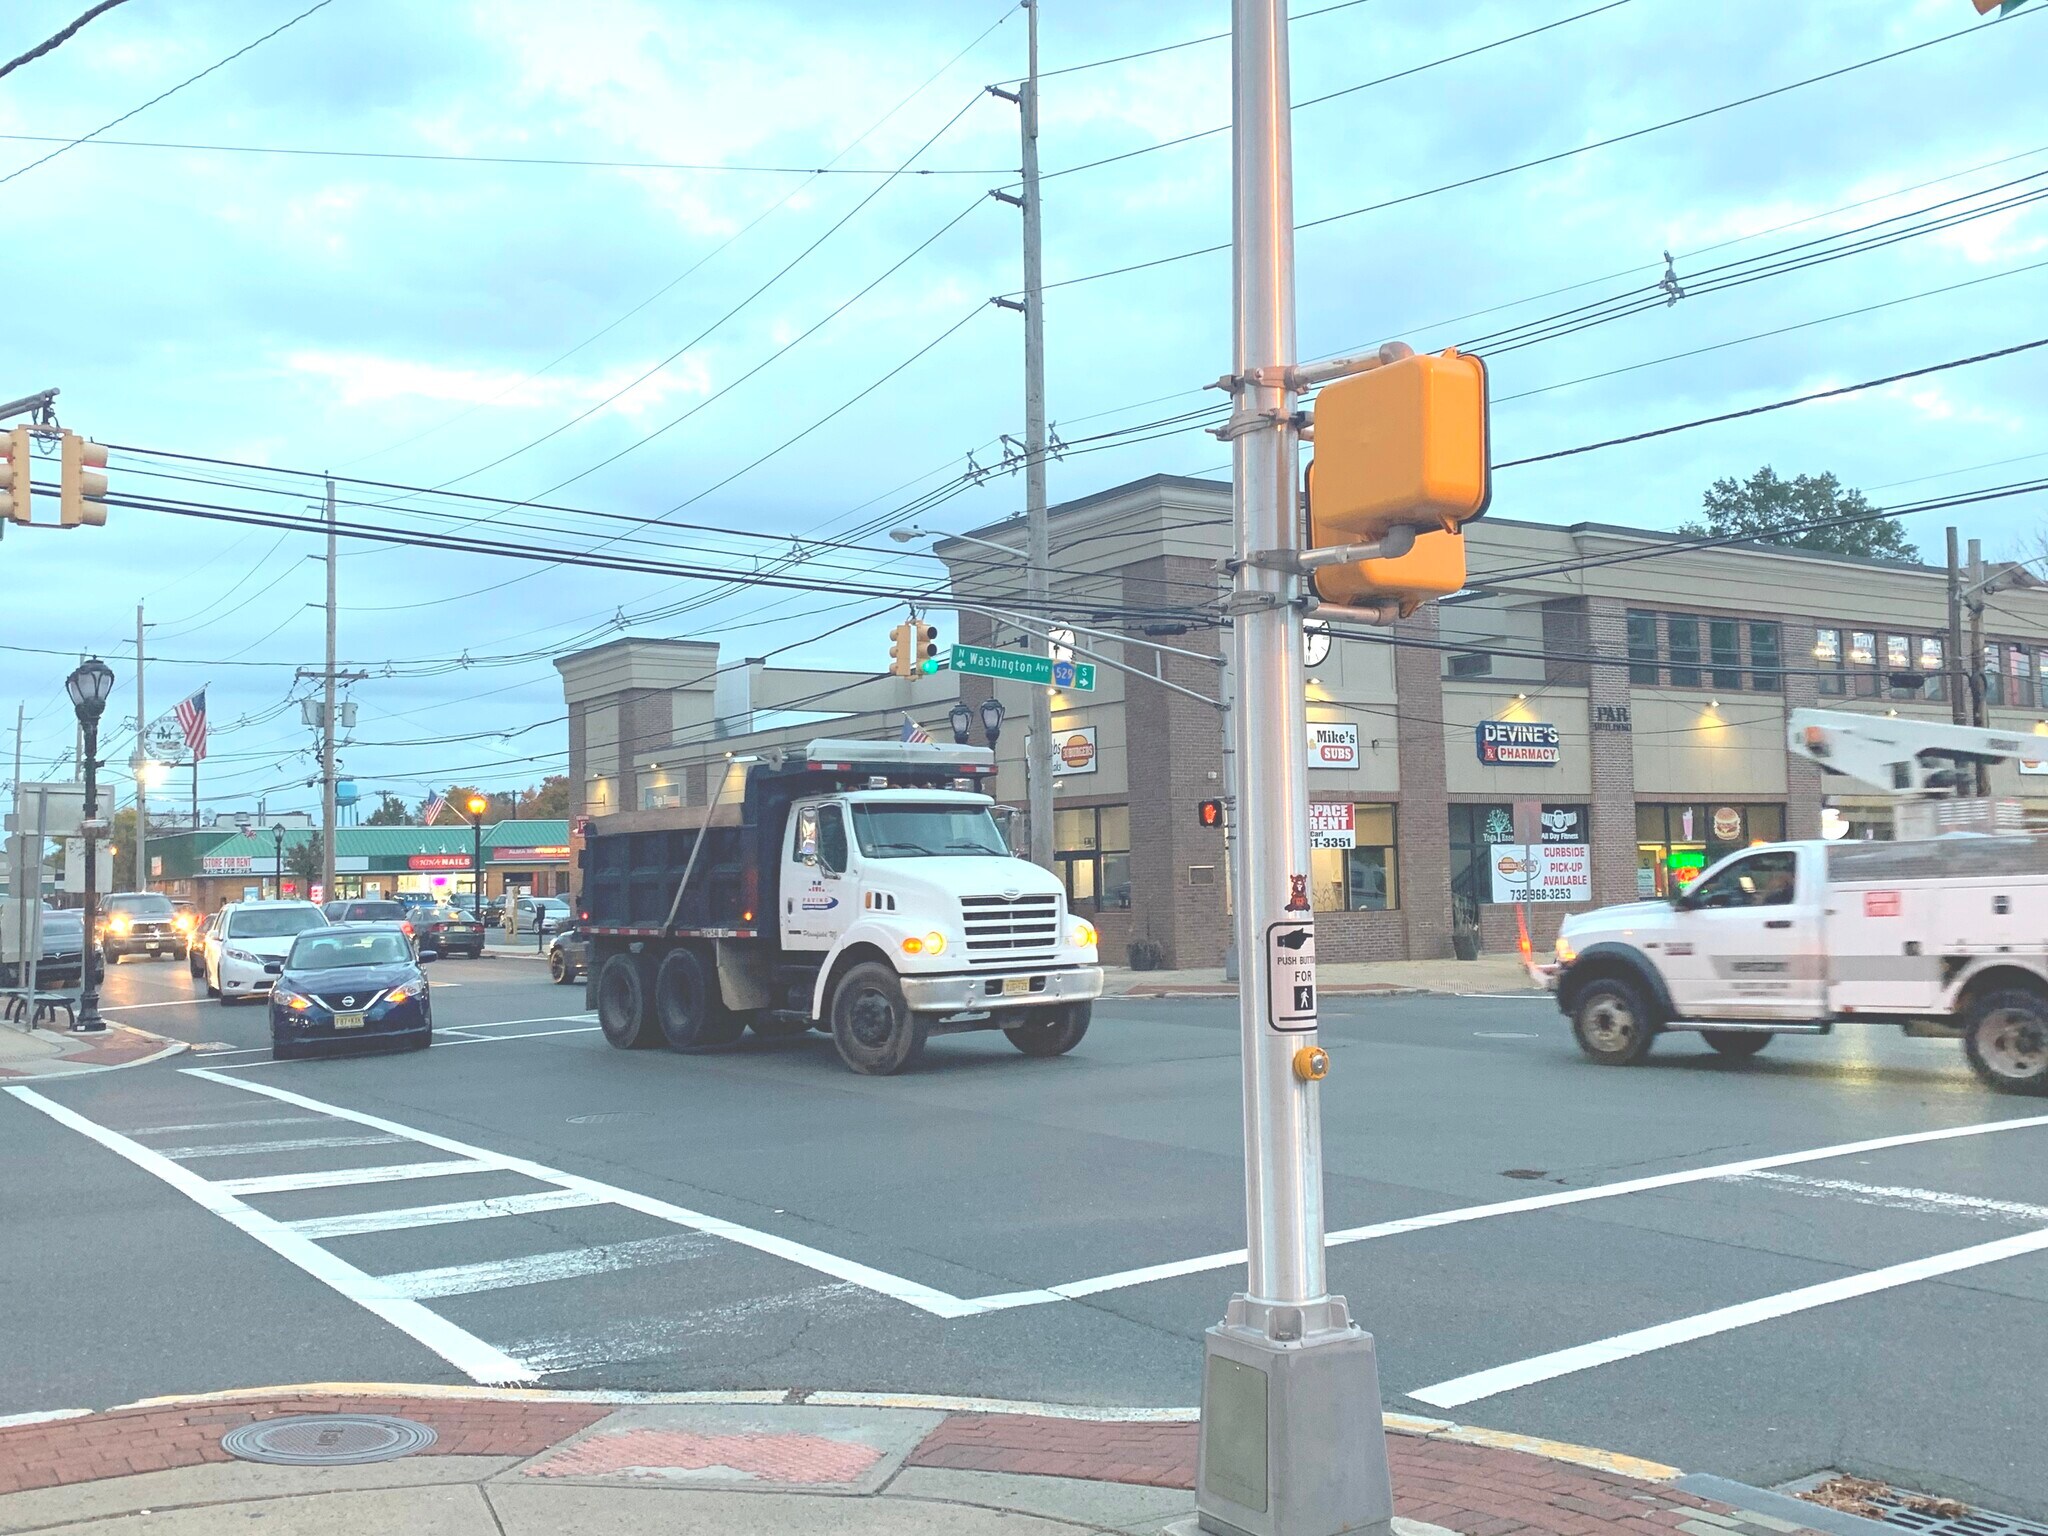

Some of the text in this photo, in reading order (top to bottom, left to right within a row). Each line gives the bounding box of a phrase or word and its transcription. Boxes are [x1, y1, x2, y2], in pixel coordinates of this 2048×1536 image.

[958, 648, 1049, 674] N Washington Ave
[1056, 667, 1073, 679] 529
[1081, 667, 1088, 677] S
[1597, 706, 1629, 722] PAR
[1316, 730, 1355, 744] Mike's
[1484, 724, 1559, 743] DEVINE'S
[1324, 747, 1351, 760] SUBS
[1500, 747, 1556, 760] PHARMACY
[1310, 816, 1349, 830] RENT
[1483, 833, 1497, 843] Yoga
[1541, 832, 1549, 840] All
[1550, 833, 1560, 842] Day
[1543, 847, 1585, 857] CURBSIDE
[204, 857, 251, 868] STORE FOR RENT
[441, 858, 470, 866] NAILS
[1550, 862, 1583, 873] PICK-UP
[1543, 875, 1587, 886] AVAILABLE
[1277, 956, 1297, 966] PUSH
[1294, 970, 1313, 983] FOR
